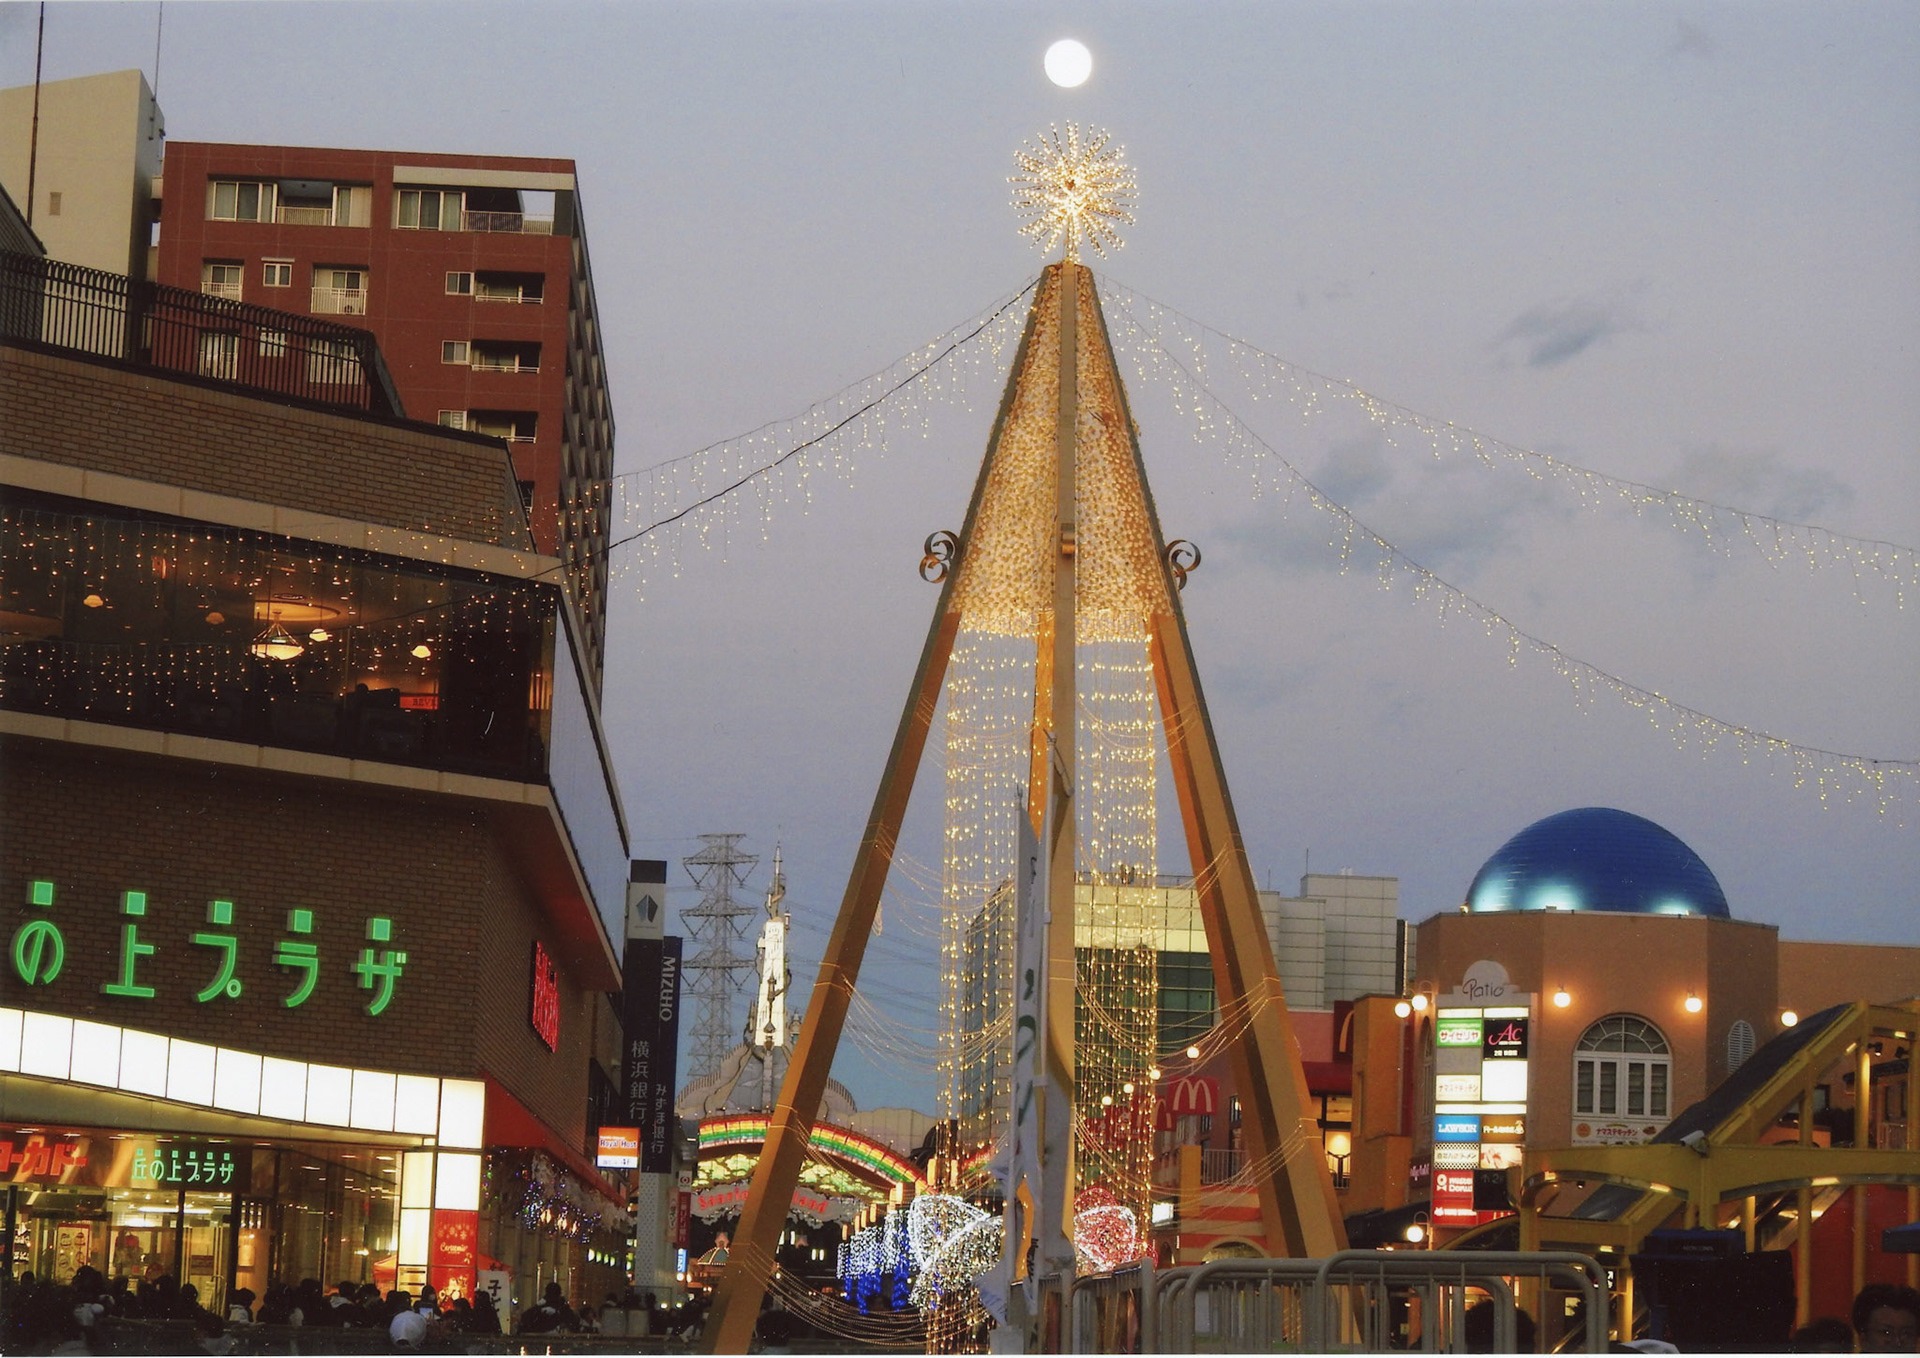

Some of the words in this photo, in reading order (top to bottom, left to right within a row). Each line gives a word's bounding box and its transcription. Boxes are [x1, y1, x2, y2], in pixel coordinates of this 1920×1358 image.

[13, 919, 407, 1017] の上プラザ
[659, 955, 676, 1022] MIZUHO
[1462, 978, 1504, 1001] Patio
[1440, 1029, 1479, 1042] サイゼリヤ
[629, 1040, 650, 1121] 横浜銀行
[651, 1083, 668, 1155] みずほ銀行
[1438, 1123, 1477, 1133] LAWSON
[600, 1139, 618, 1149] Royal
[620, 1140, 637, 1149] Host
[132, 1157, 235, 1184] 丘の上プラザ
